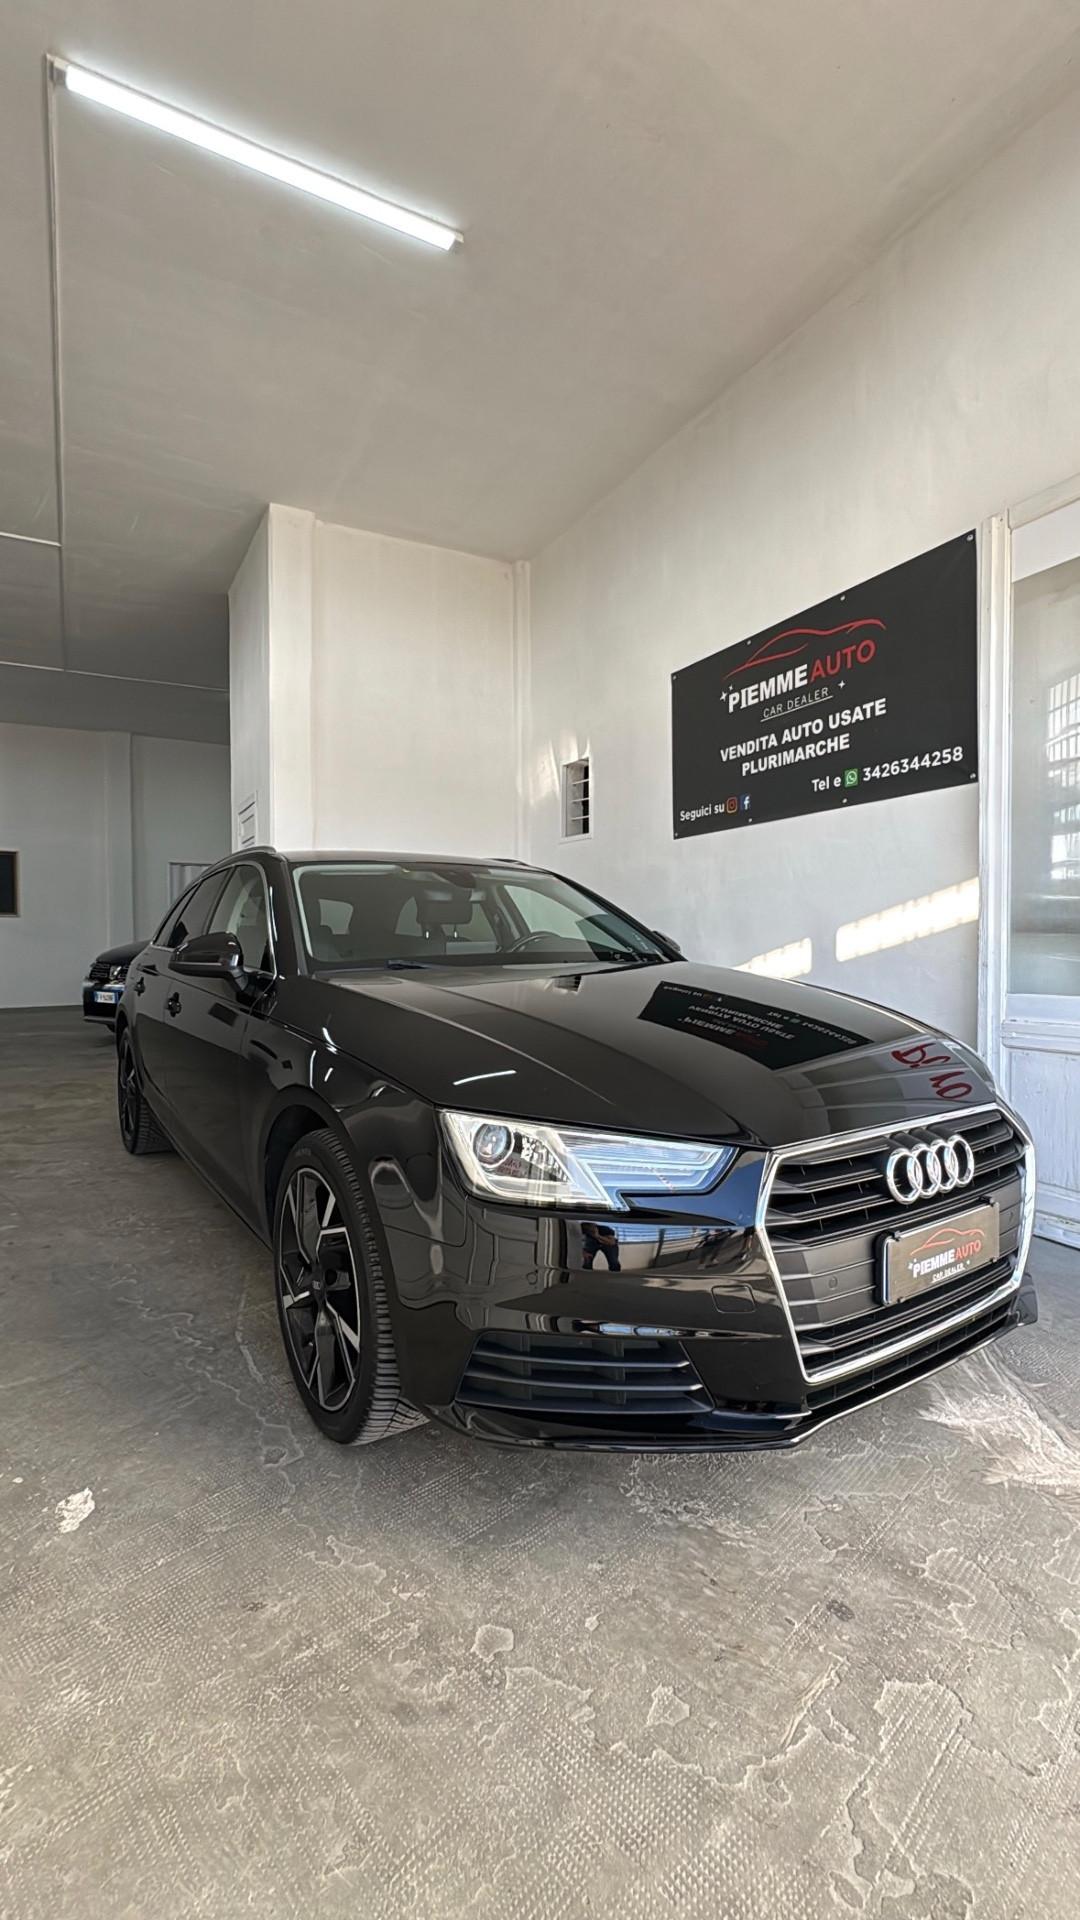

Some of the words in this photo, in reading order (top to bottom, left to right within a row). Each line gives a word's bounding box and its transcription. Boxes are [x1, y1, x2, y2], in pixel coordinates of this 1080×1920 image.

[763, 703, 783, 718] CAR
[787, 687, 829, 710] DEALER
[720, 733, 778, 762] VENDITA
[781, 718, 824, 745] AUTO
[828, 698, 887, 730] USATE
[742, 733, 850, 777] PLURIMARCHE
[812, 776, 830, 792] Tel
[833, 776, 842, 788] e
[862, 746, 964, 782] 3426344258
[680, 803, 712, 822] Seguici
[714, 802, 725, 814] su
